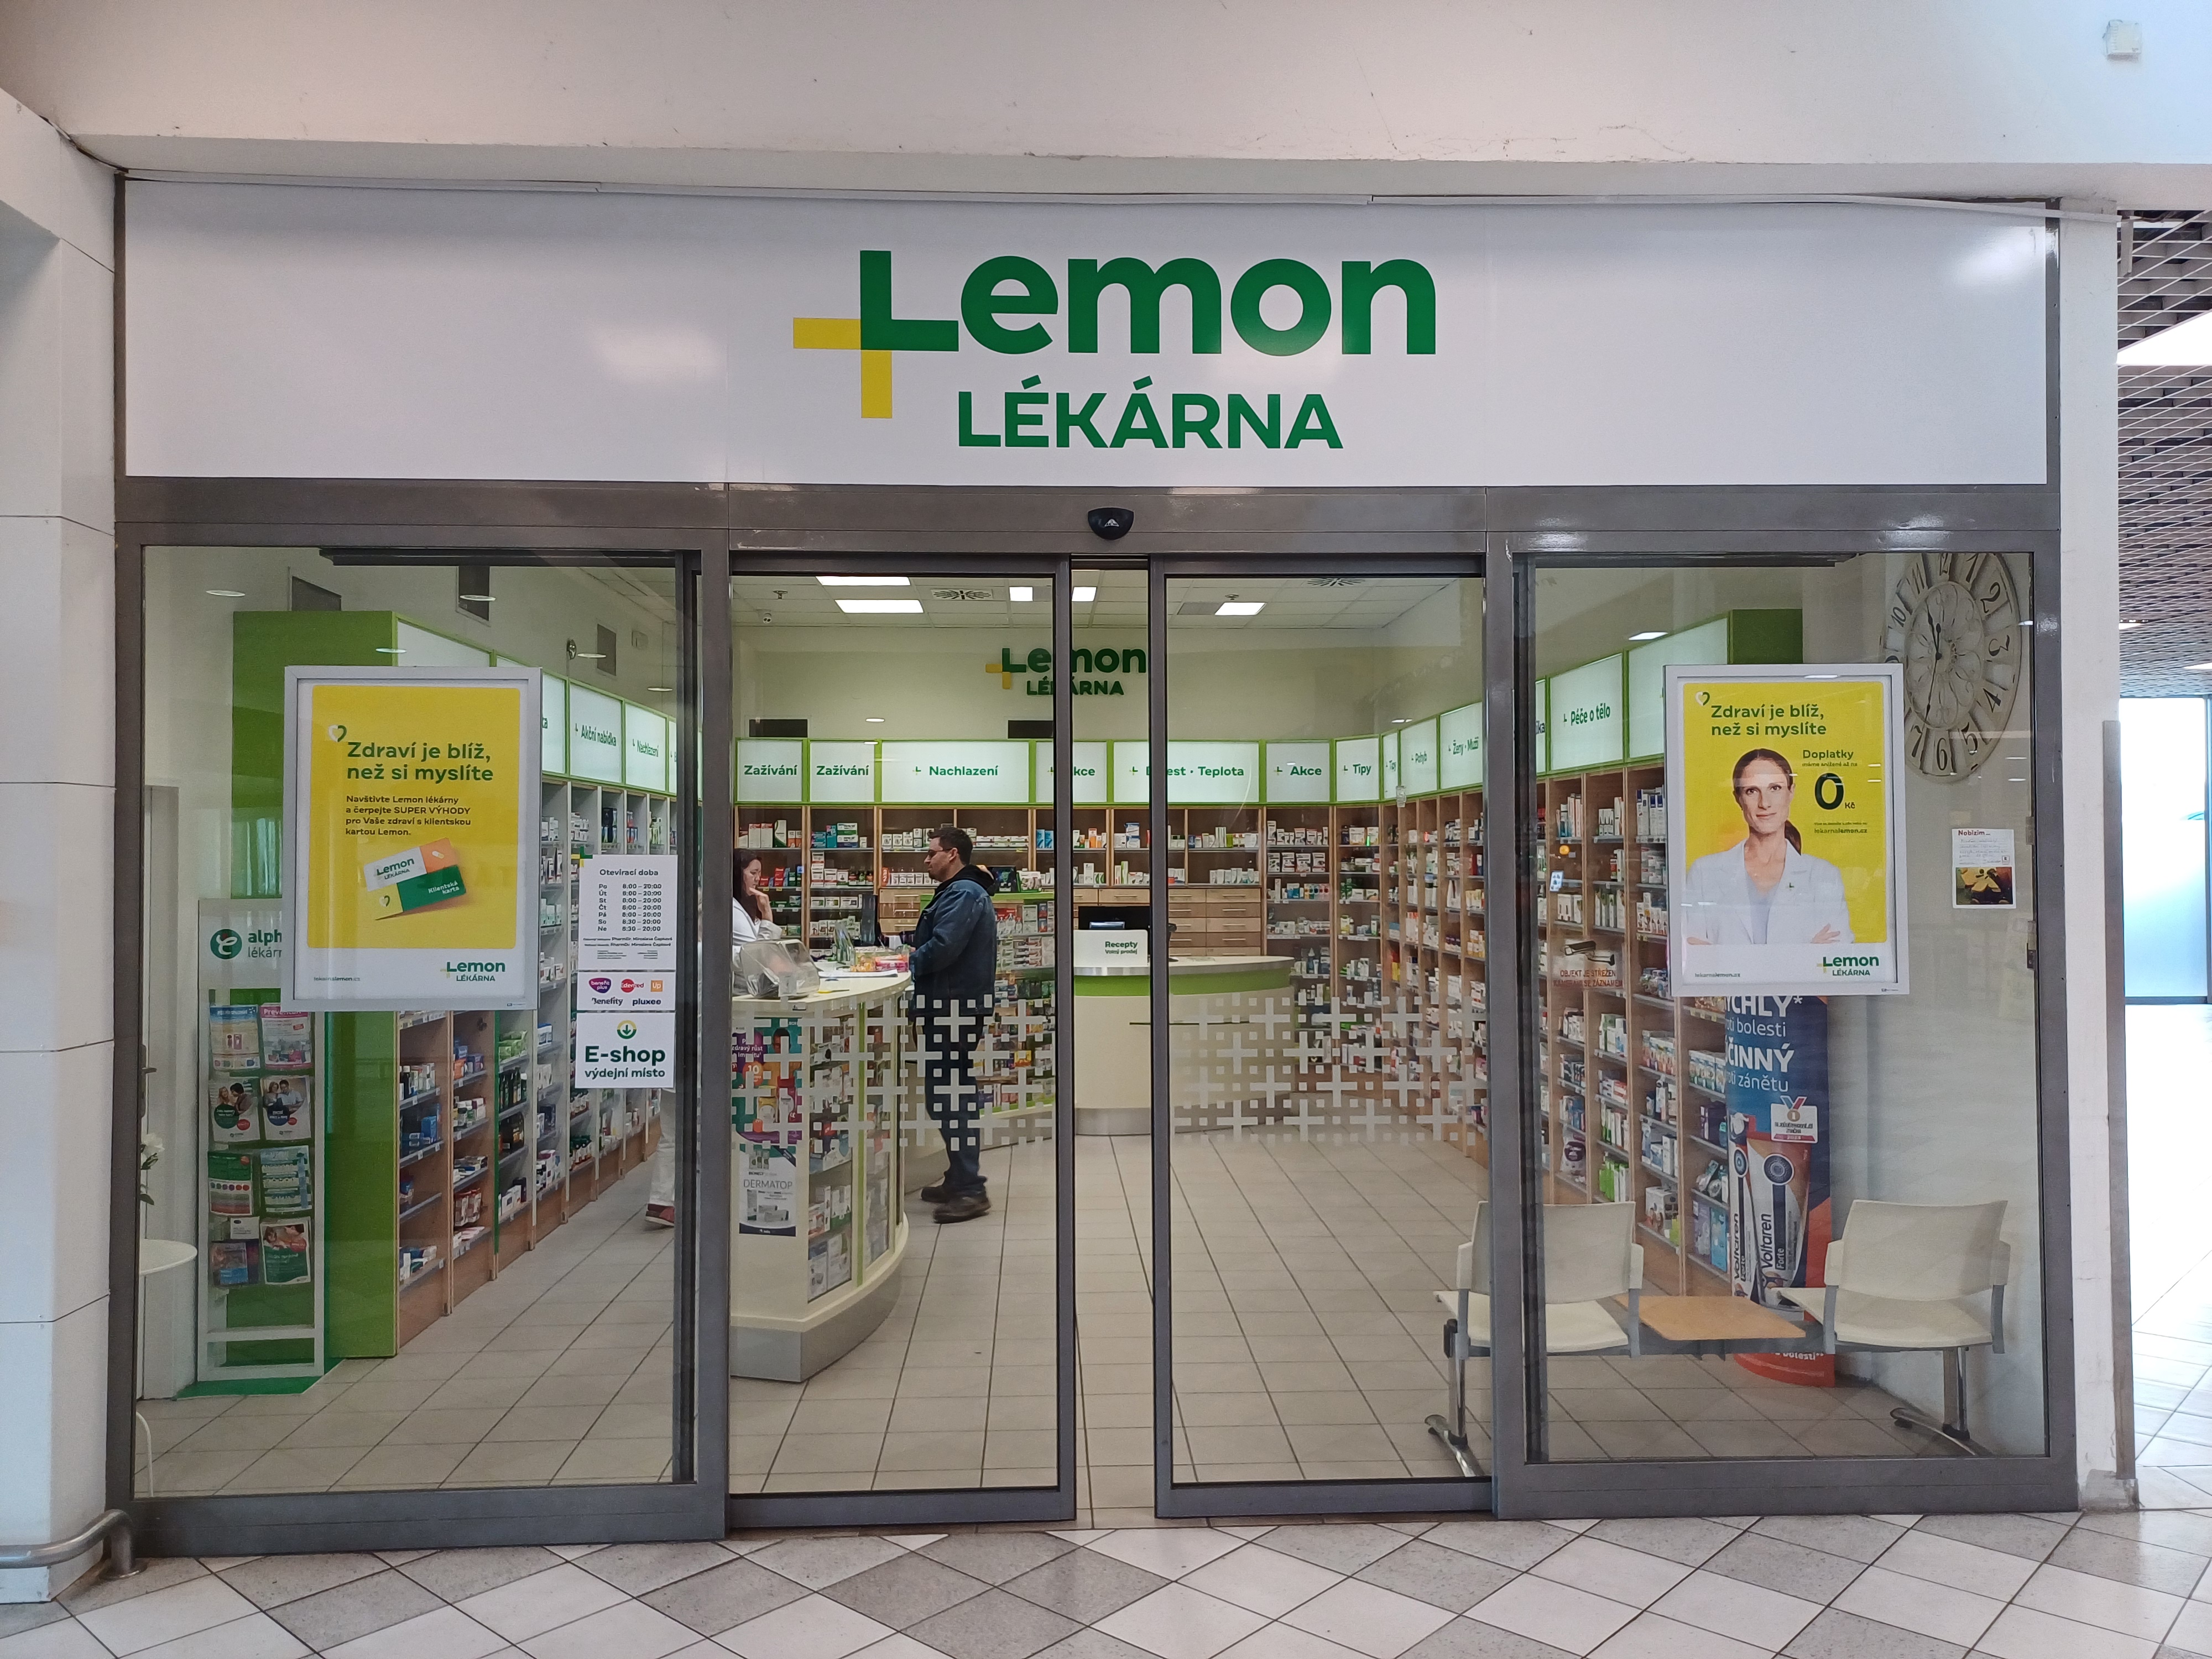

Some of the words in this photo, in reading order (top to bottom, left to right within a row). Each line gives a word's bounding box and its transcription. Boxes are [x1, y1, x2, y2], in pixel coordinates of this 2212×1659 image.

[860, 251, 1436, 356] Lemon
[959, 375, 1343, 448] LÉKÁRNA
[1980, 582, 2001, 613] 2
[1988, 635, 2010, 658] 3
[1983, 687, 2001, 713] 4
[1571, 708, 1588, 726] Péče
[1589, 711, 1594, 722] o
[1596, 702, 1610, 719] tělo
[1711, 704, 1765, 718] Zdraví
[1770, 705, 1785, 721] je
[1790, 703, 1824, 720] blíž,
[581, 724, 597, 742] Akční
[597, 731, 617, 747] nabídka
[1712, 722, 1741, 735] než
[1746, 722, 1759, 735] si
[1765, 721, 1827, 738] myslíte
[1961, 722, 1978, 753] 5
[1911, 724, 1922, 758] 7
[347, 741, 416, 758] Zdraví
[421, 743, 441, 762] je
[448, 742, 491, 763] blíž,
[1803, 749, 1854, 760] Doplatky
[1937, 738, 1948, 771] 6
[347, 763, 384, 779] než
[392, 764, 408, 780] si
[415, 764, 493, 784] myslíte
[744, 765, 797, 776] Zažívání
[816, 765, 869, 776] Zažívání
[929, 765, 999, 776] Nachlazení
[1073, 766, 1095, 776] kce
[1198, 766, 1244, 778] Teplota
[1290, 766, 1322, 776] Akce
[1353, 764, 1371, 776] Tipy
[426, 795, 459, 805] lékárny
[1814, 773, 1844, 810] 0
[354, 806, 392, 815] čerpejte
[429, 805, 471, 814] VÝHODY
[377, 858, 415, 876] Lemon
[446, 961, 505, 972] Lemon
[1823, 956, 1879, 967] Lemon
[1737, 1018, 1786, 1037] bolesti
[585, 1046, 666, 1066] E-shop
[1725, 1035, 1794, 1073] ČINNÝ
[585, 1067, 629, 1079] výdejní
[632, 1067, 665, 1077] místo
[1738, 1073, 1788, 1092] zánětu
[743, 1179, 793, 1189] DERMATOP
[1760, 1213, 1773, 1269] Voltaren
[1776, 1247, 1785, 1269] Forte
